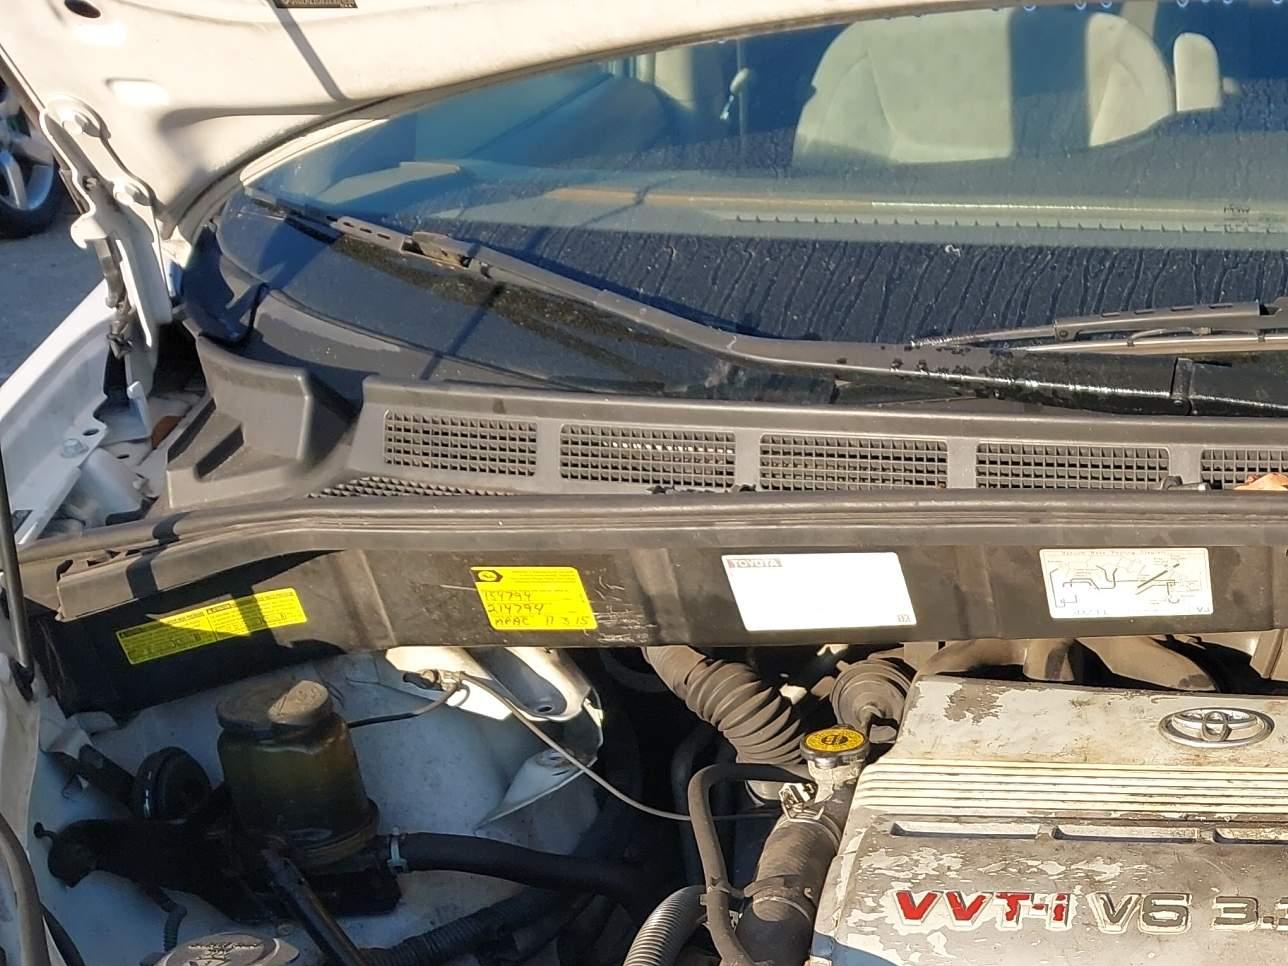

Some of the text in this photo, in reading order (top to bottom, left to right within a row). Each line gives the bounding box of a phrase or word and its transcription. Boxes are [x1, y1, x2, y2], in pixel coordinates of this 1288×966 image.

[732, 558, 780, 568] TOYOTA
[895, 891, 1076, 931] VVT-i
[1087, 892, 1193, 934] V6
